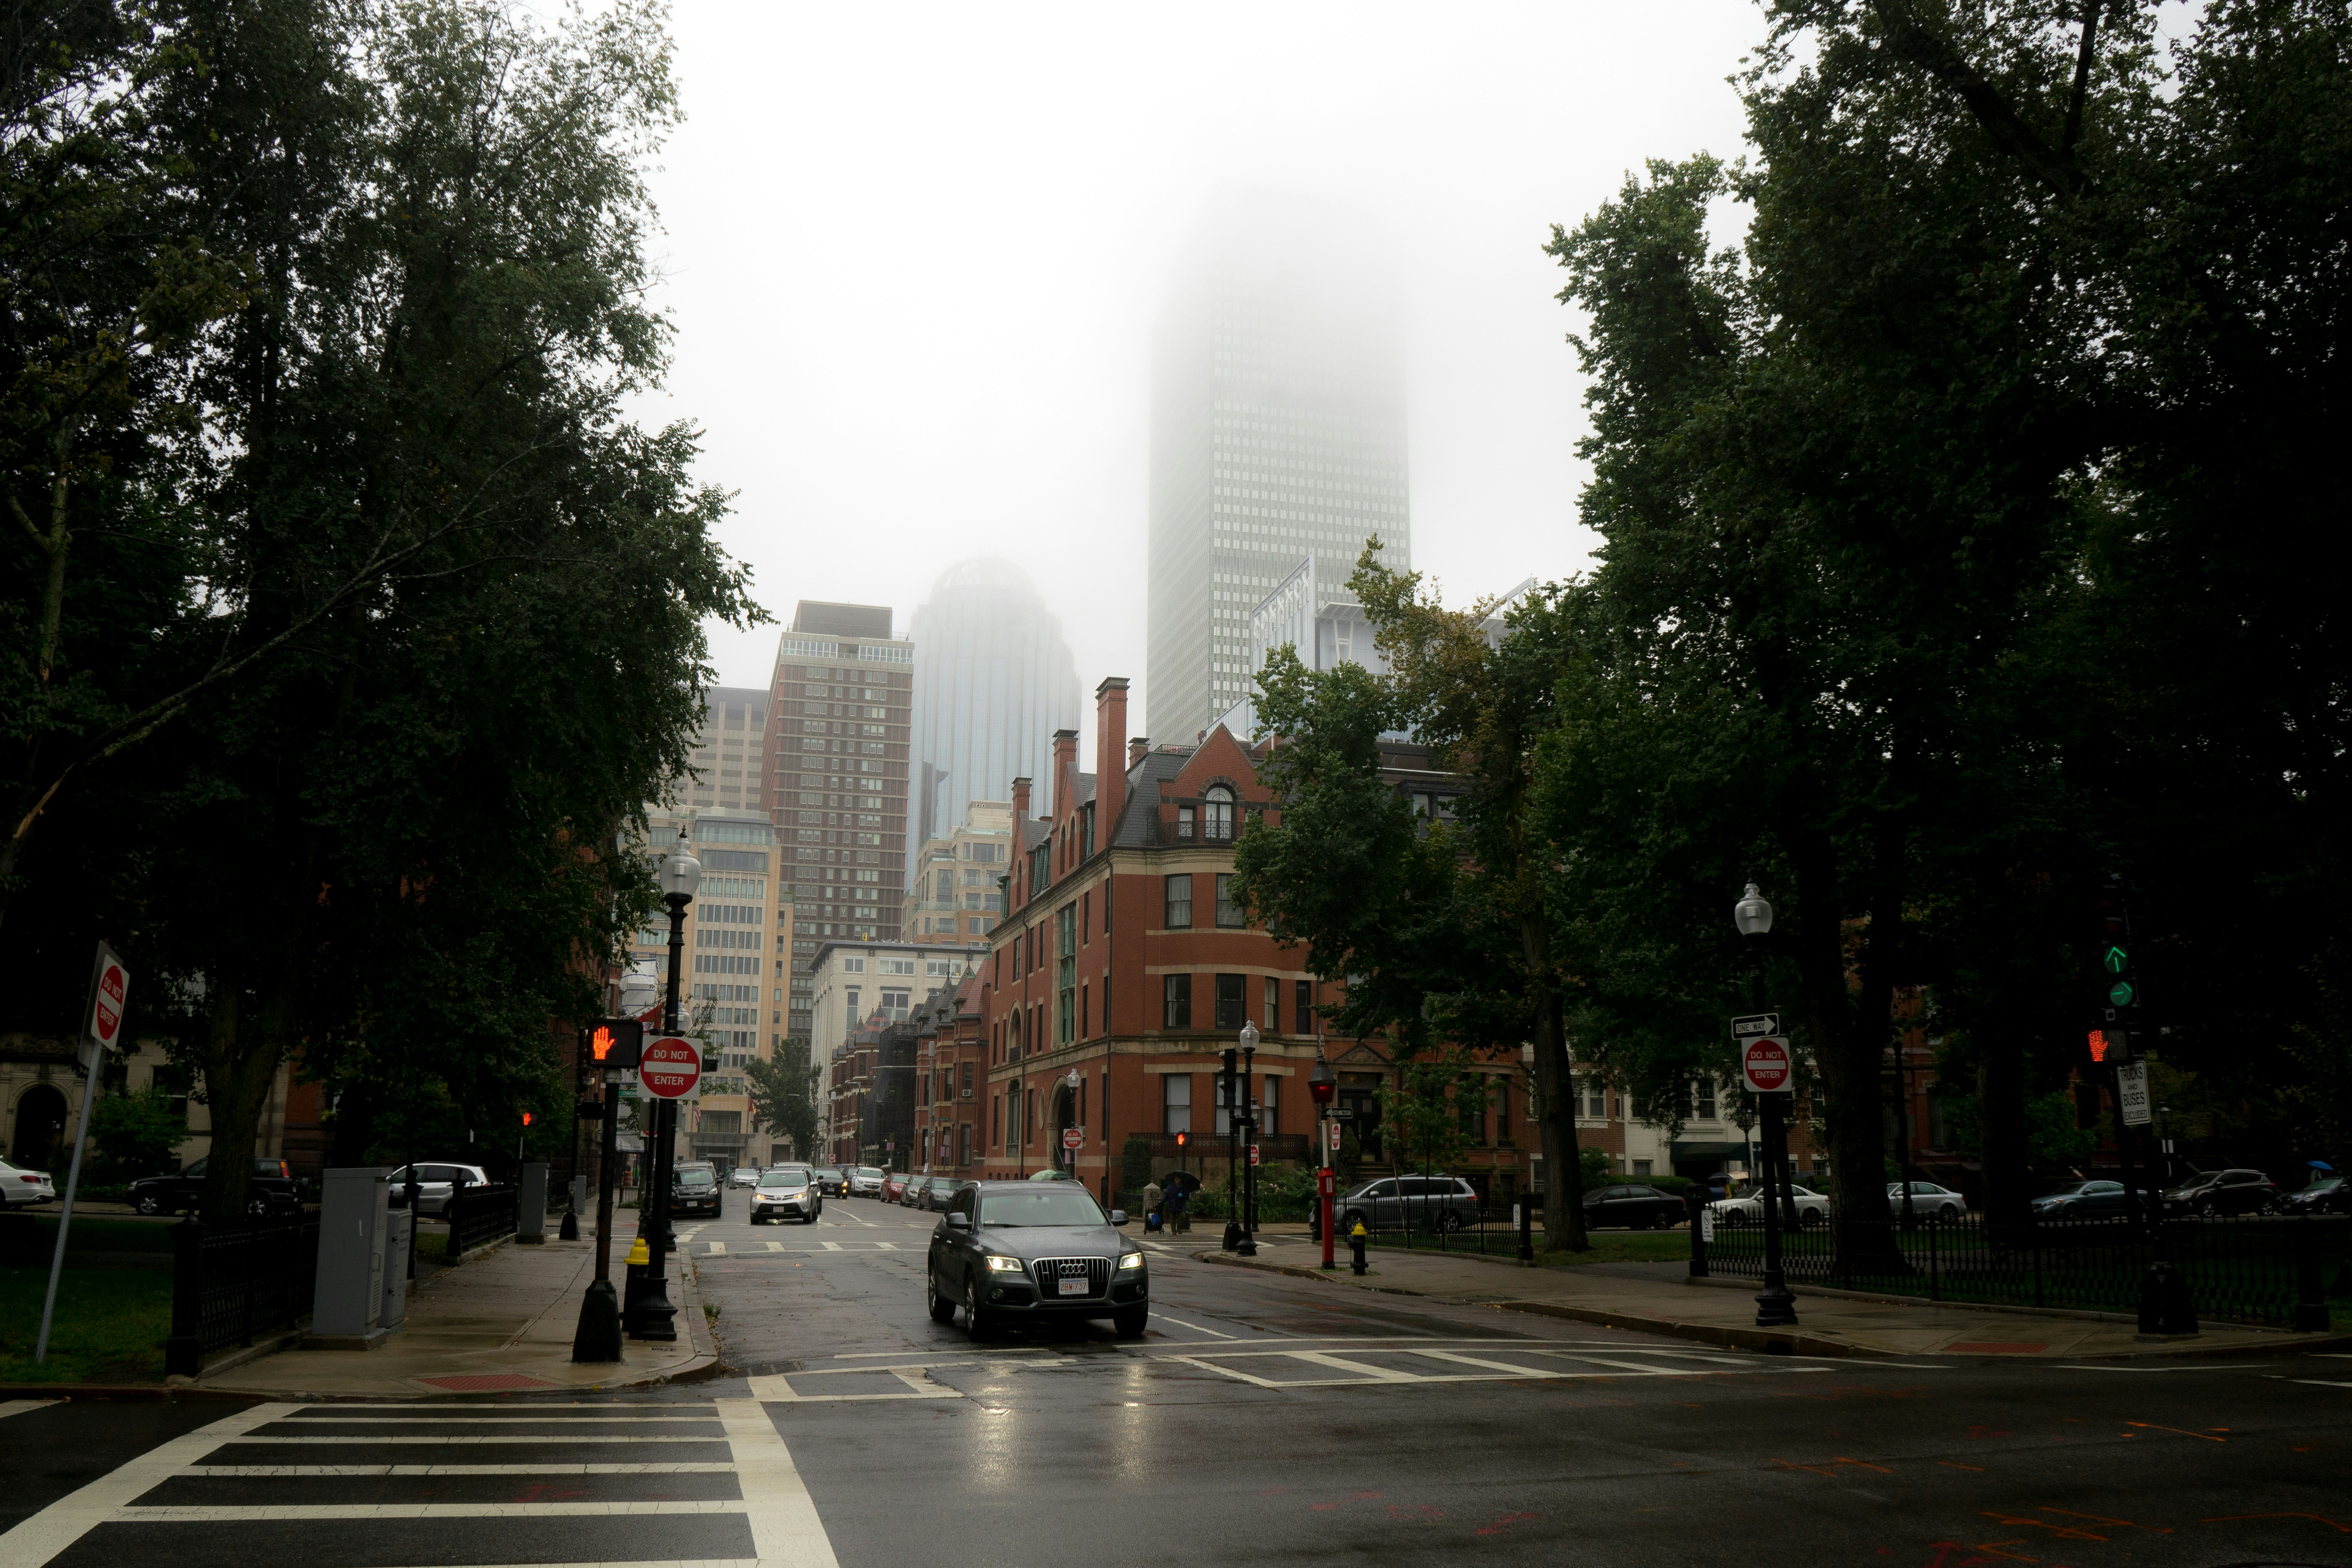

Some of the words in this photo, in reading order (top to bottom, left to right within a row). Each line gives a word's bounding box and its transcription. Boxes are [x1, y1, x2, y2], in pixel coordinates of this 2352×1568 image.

[103, 976, 112, 991] DO
[112, 984, 122, 1000] NOT
[100, 1006, 114, 1027] ENTER
[1738, 1024, 1749, 1032] ONE
[1753, 1022, 1764, 1030] WAY
[654, 1049, 666, 1058] DO
[671, 1050, 689, 1060] NOT
[2120, 1066, 2143, 1082] TRUCKS
[654, 1075, 684, 1085] ENTER
[2123, 1091, 2145, 1107] BUSES
[2124, 1109, 2147, 1120] EXCLUDED
[1060, 1283, 1073, 1291] 2BW
[1074, 1282, 1086, 1290] 737
